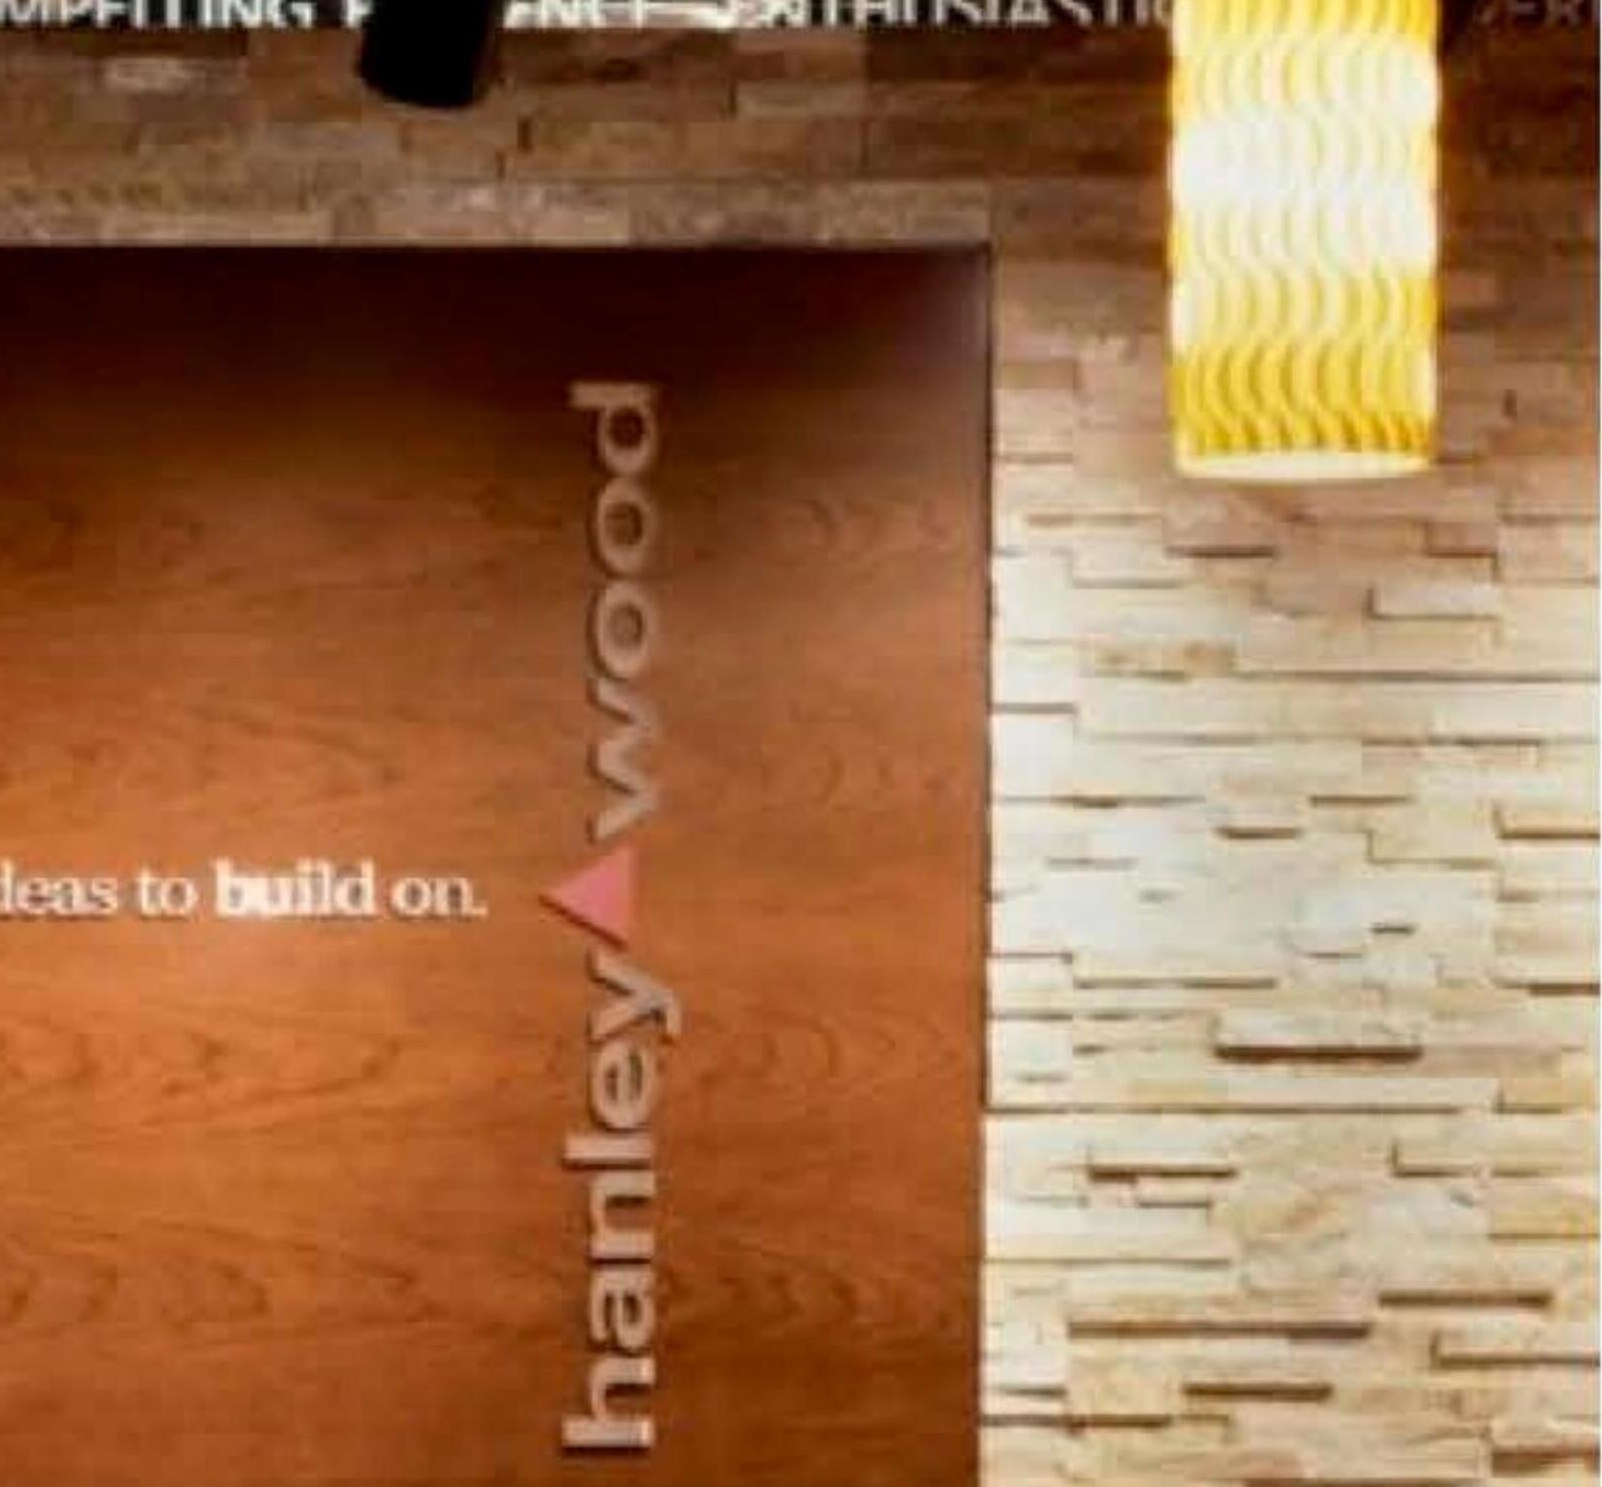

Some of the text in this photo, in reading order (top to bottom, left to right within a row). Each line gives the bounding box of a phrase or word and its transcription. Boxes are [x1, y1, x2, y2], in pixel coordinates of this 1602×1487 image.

[136, 865, 198, 917] to
[213, 857, 378, 917] build
[392, 873, 490, 917] on.
[560, 379, 683, 1456] hanley wood
